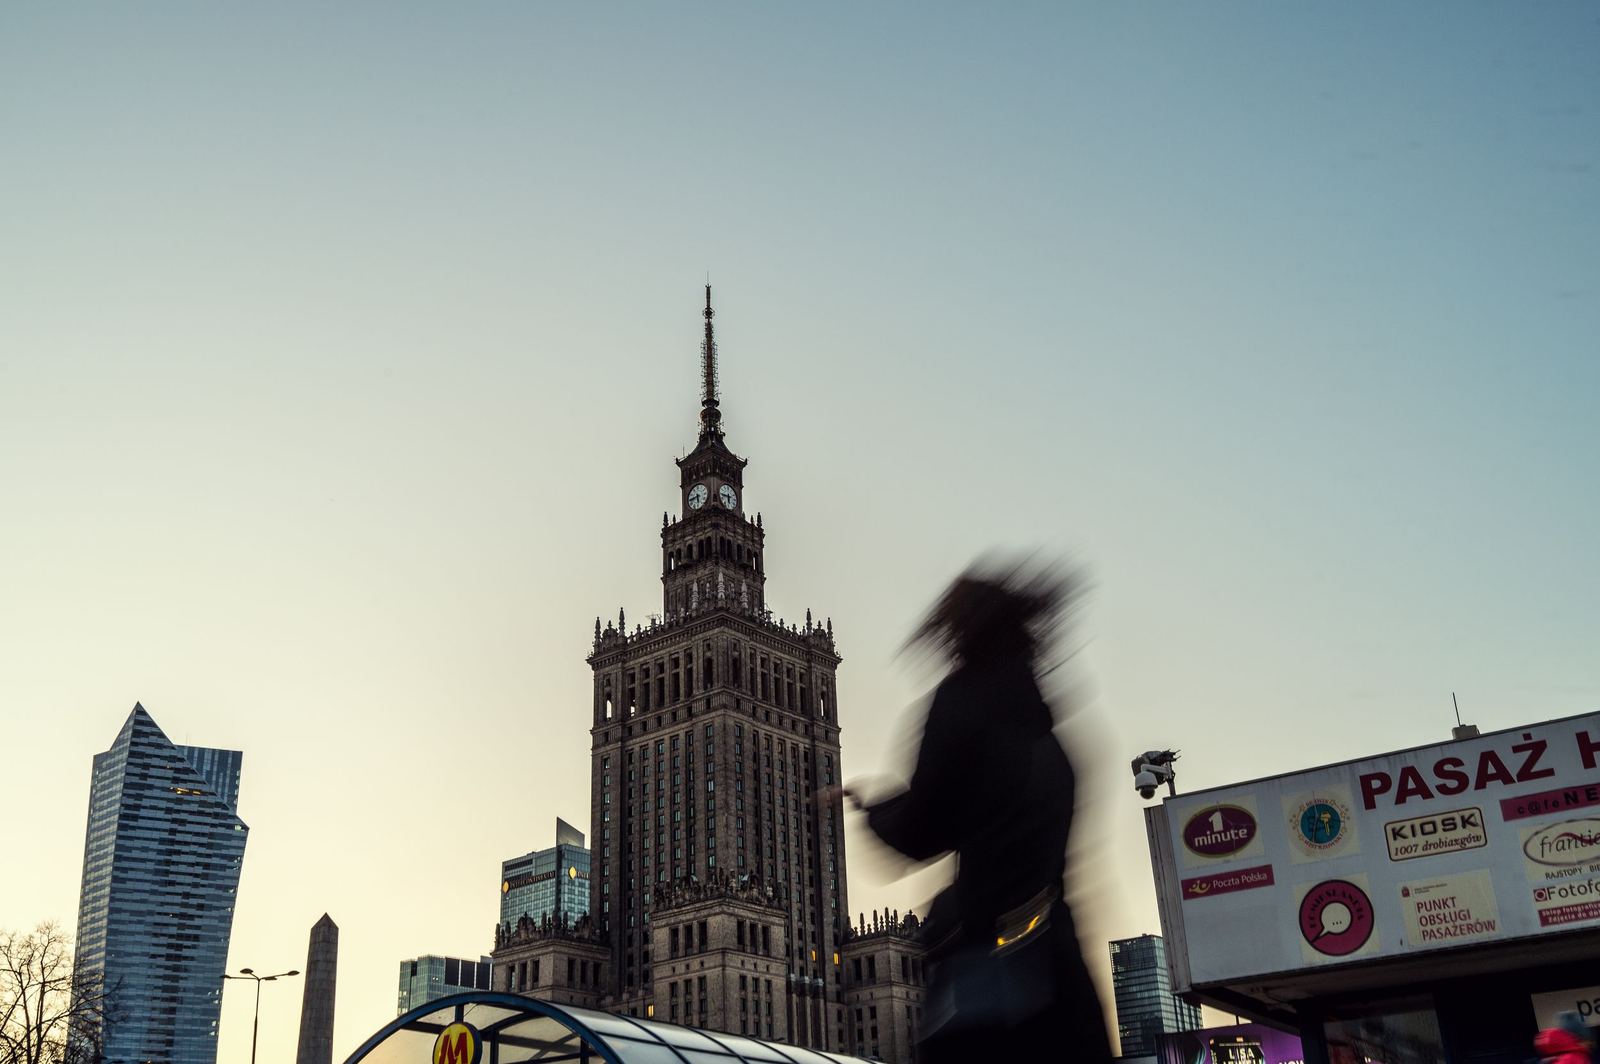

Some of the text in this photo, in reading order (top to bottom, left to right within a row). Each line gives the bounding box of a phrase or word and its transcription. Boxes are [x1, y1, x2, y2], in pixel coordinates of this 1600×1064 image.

[1359, 733, 1555, 811] PASAŻ
[1208, 811, 1224, 833] 1
[1391, 813, 1480, 841] KIOSK
[1194, 828, 1248, 847] minute
[1213, 872, 1268, 889] Poczta Polska
[1545, 867, 1583, 880] RAJSTOPY
[1416, 896, 1457, 914] PUNKT
[1419, 908, 1472, 928] OBSŁUGI
[1421, 918, 1496, 941] PASAŻERÓW
[1229, 1047, 1255, 1060] LISA
